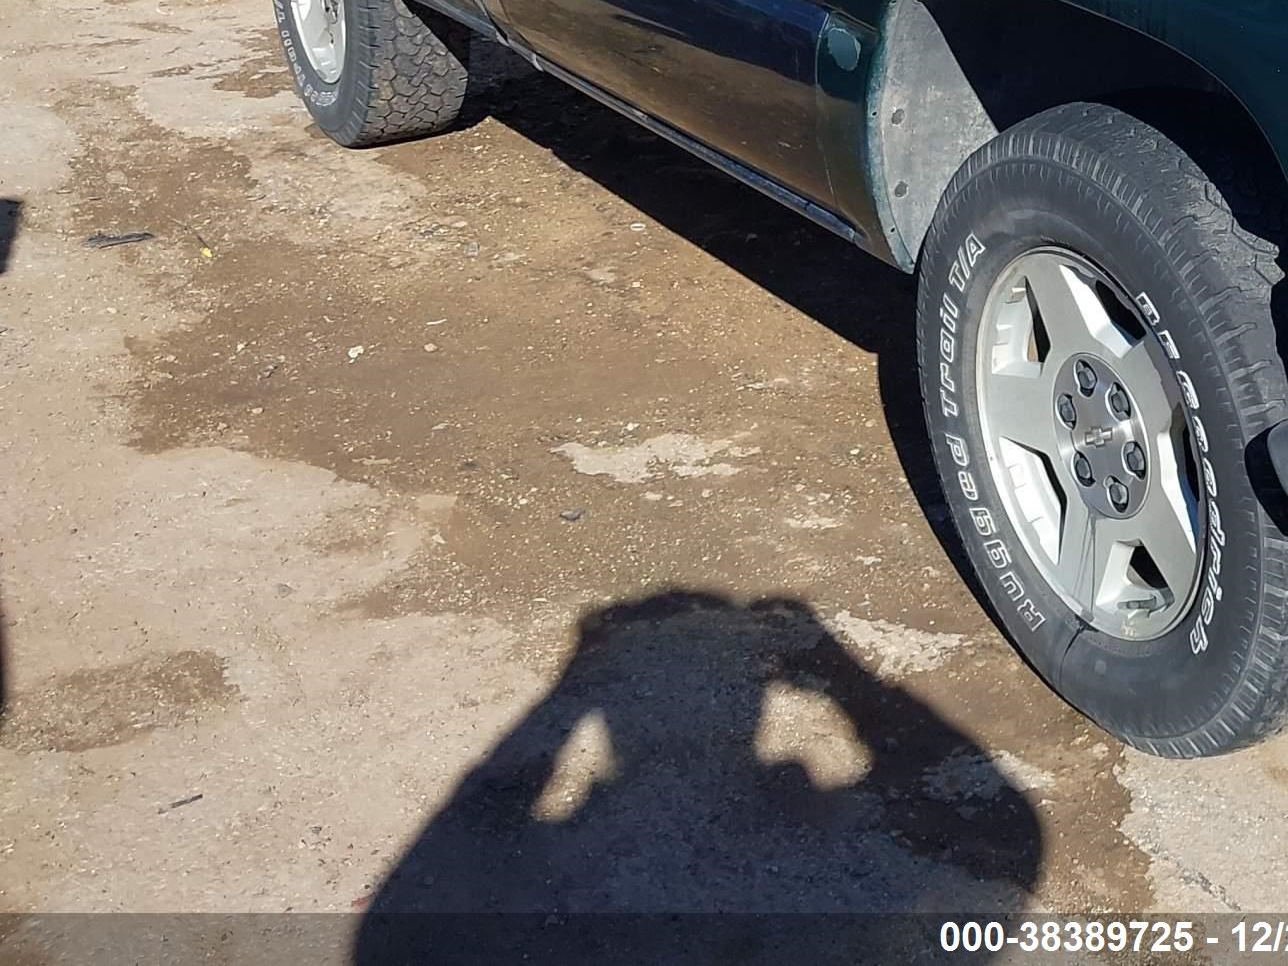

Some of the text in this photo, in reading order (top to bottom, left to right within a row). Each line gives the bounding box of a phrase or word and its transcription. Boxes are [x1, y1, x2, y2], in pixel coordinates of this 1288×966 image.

[940, 233, 1047, 633] Rugged Trail T/A
